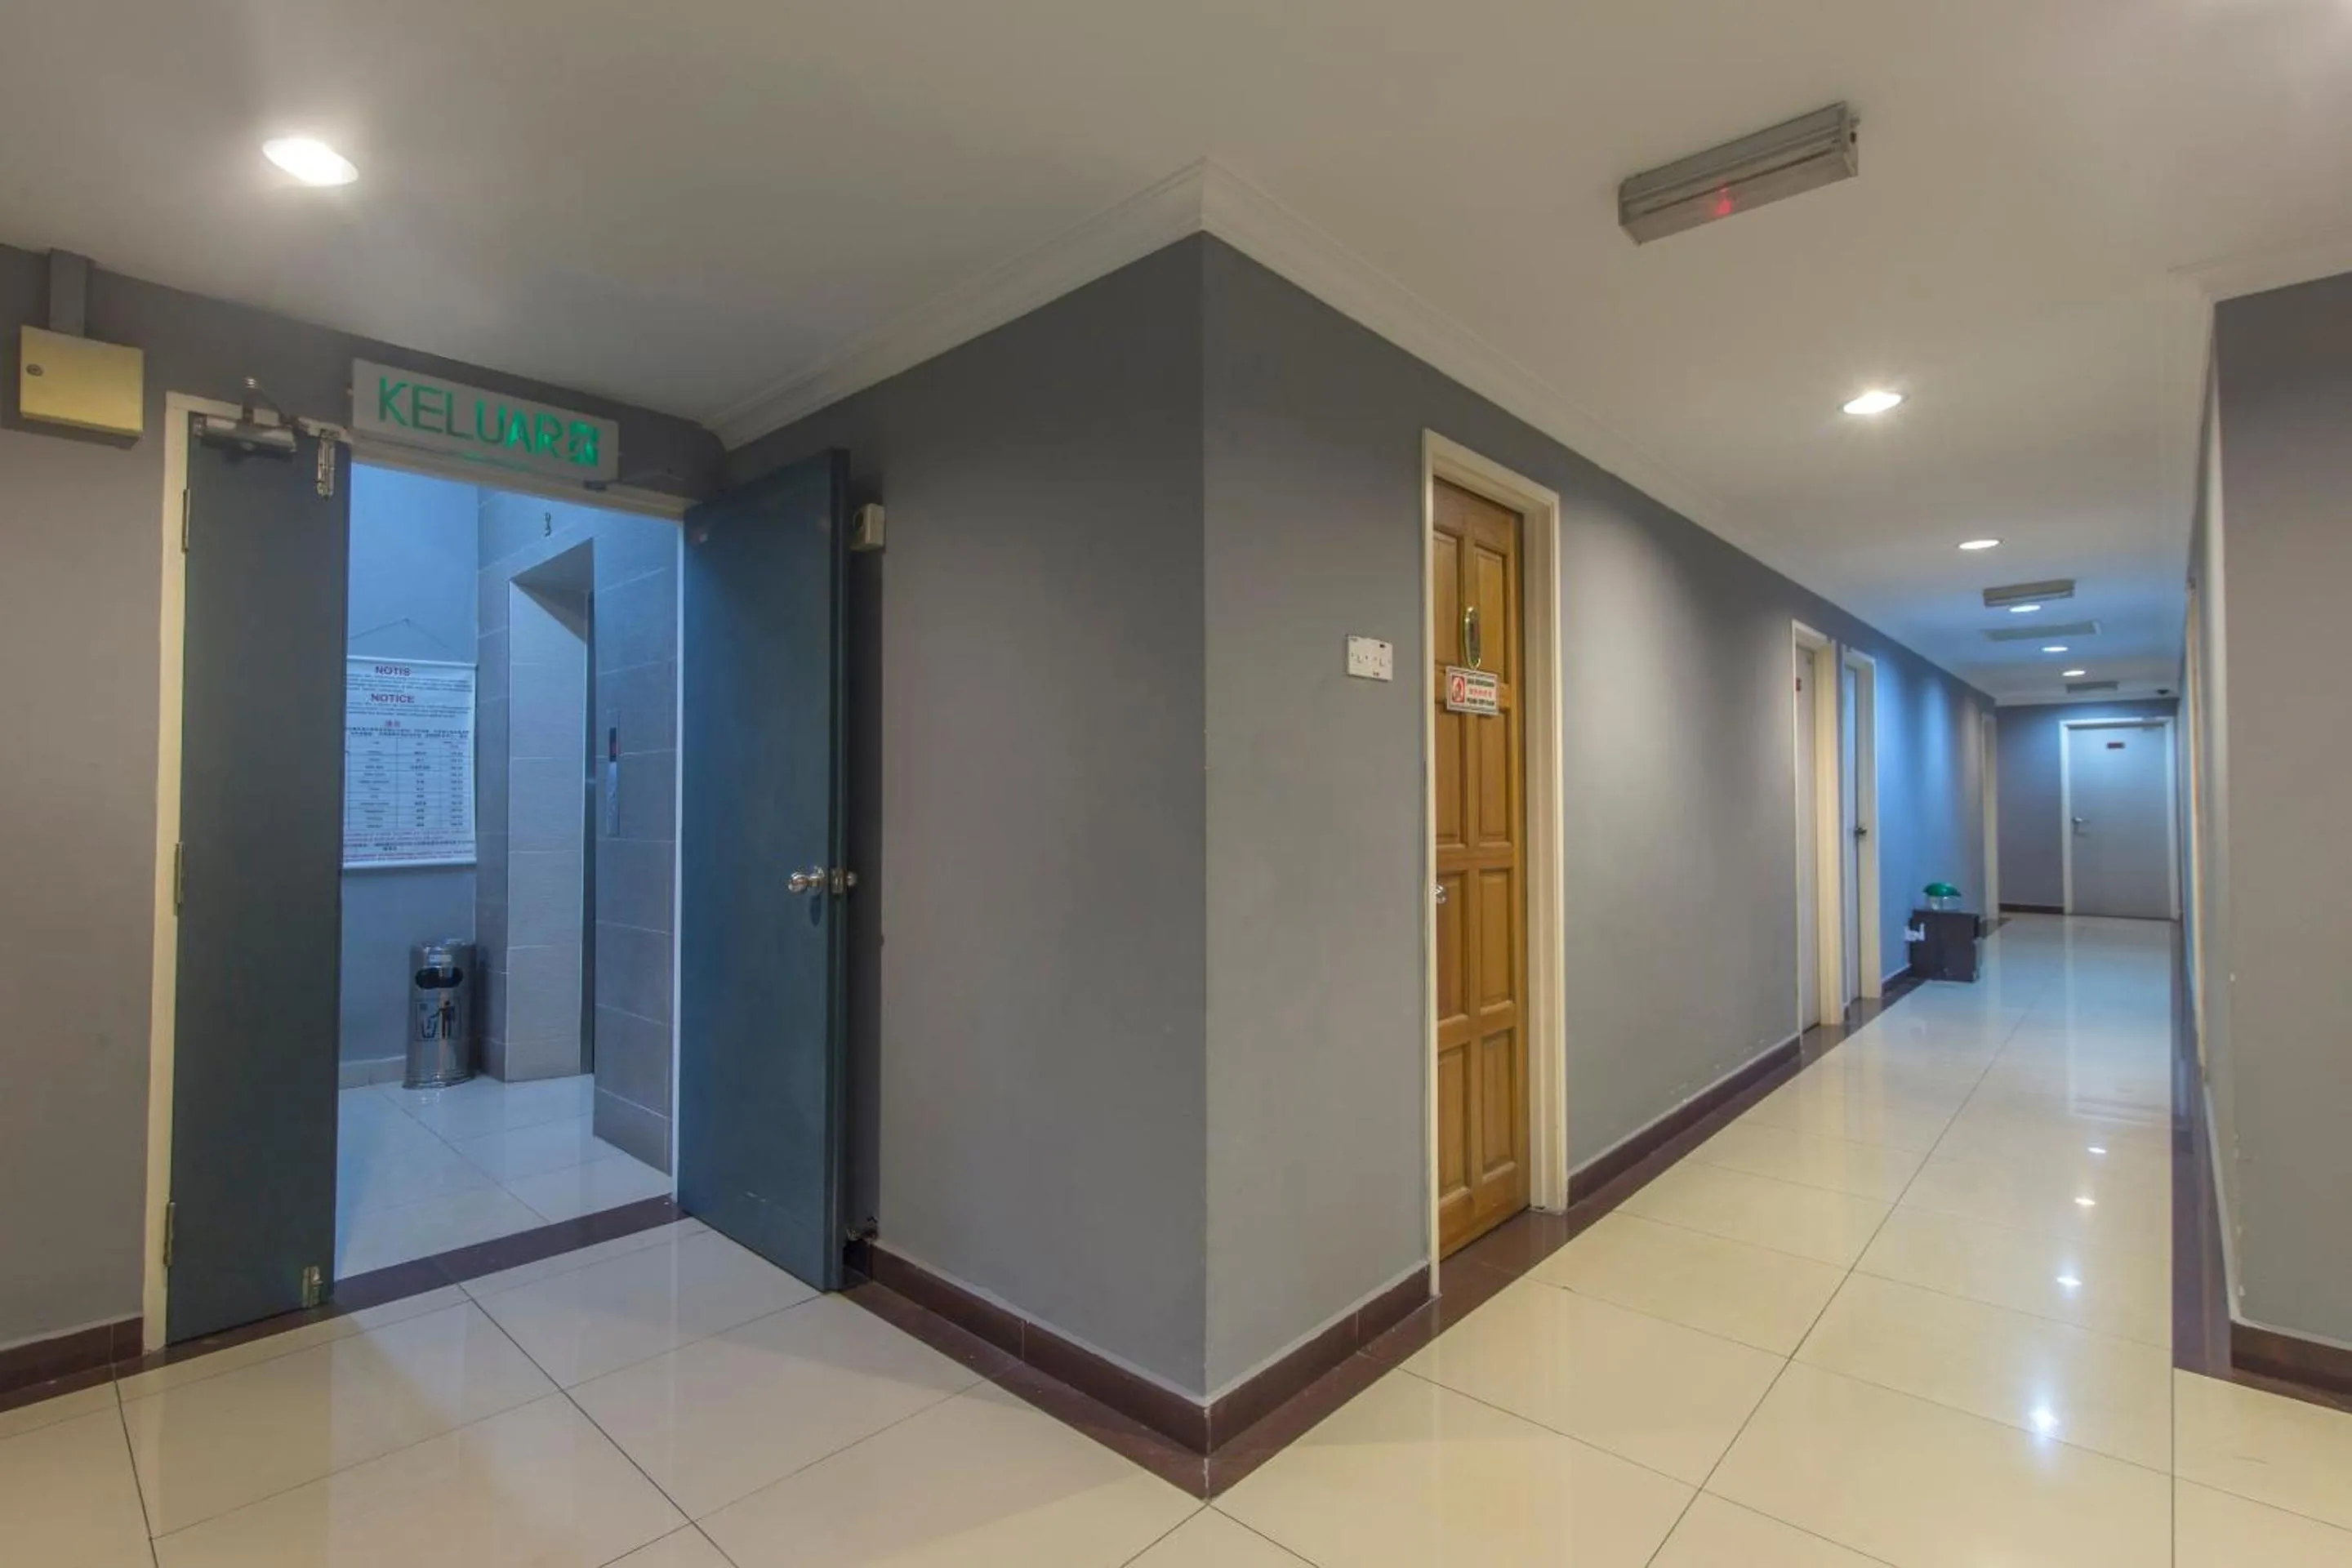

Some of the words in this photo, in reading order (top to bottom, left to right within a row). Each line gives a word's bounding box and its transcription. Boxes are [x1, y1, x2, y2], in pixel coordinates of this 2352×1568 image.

[378, 376, 563, 459] KELUAR
[375, 665, 412, 676] NOTIS
[371, 693, 416, 704] NOTICE
